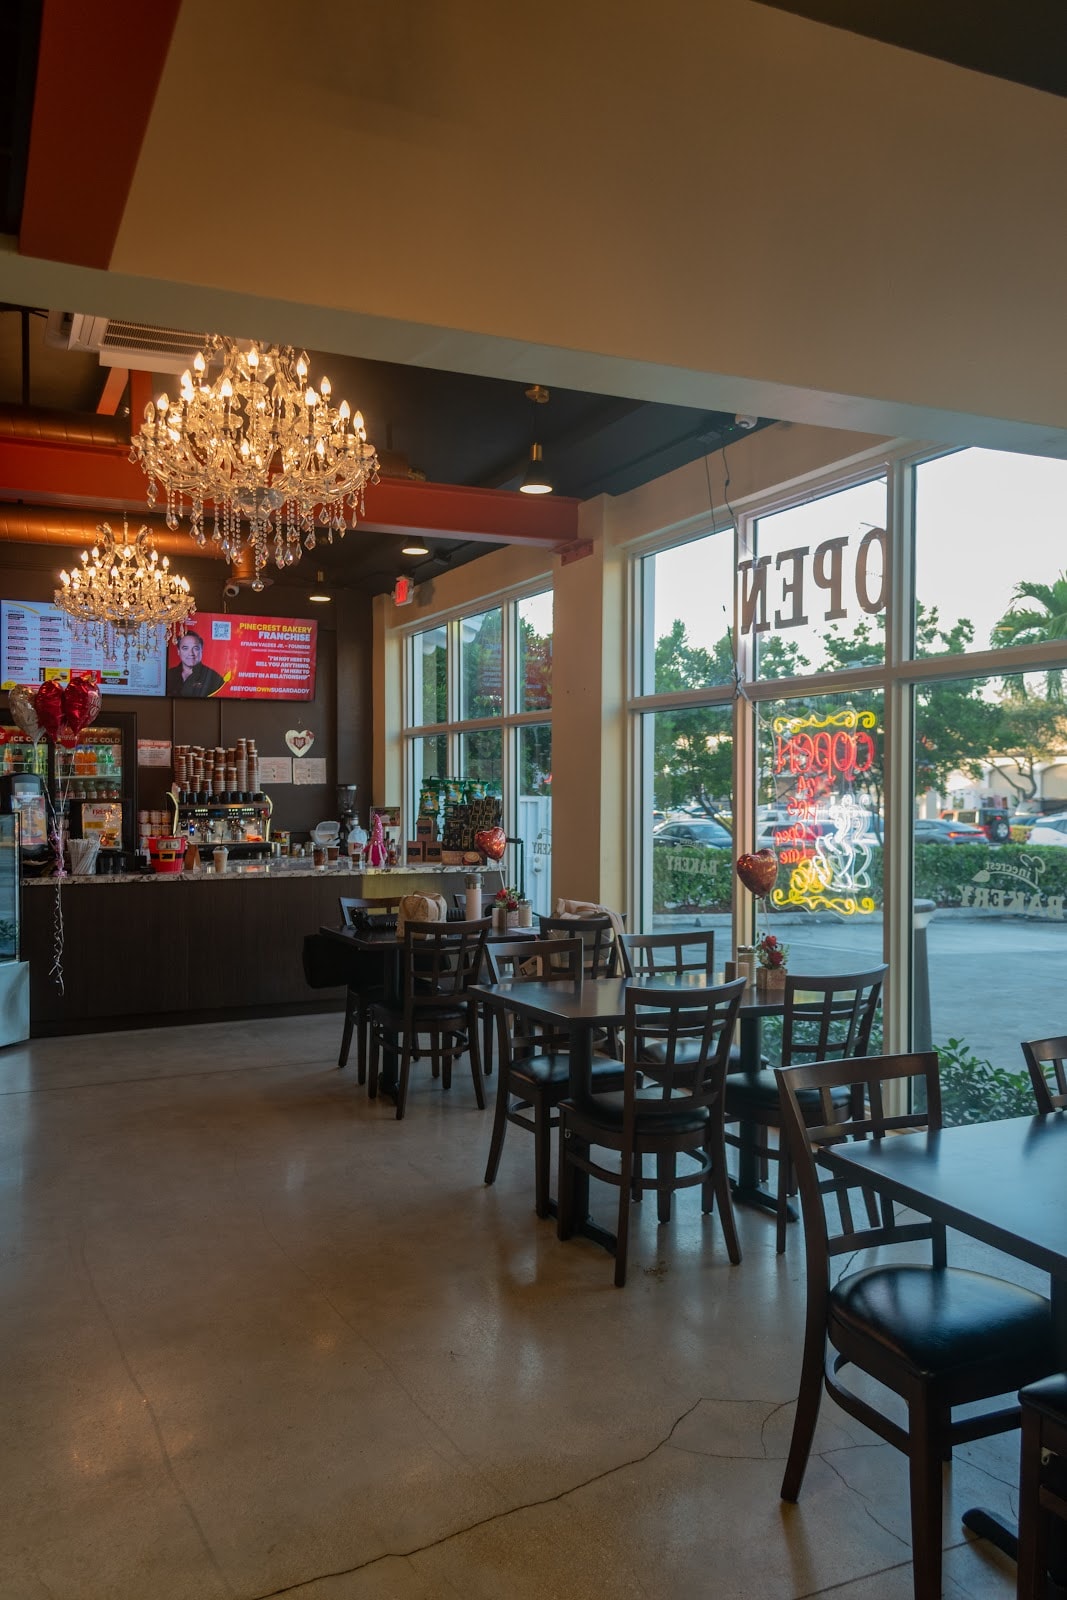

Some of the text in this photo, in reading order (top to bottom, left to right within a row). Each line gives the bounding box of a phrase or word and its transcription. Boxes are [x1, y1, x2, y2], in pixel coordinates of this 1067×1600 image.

[239, 622, 312, 633] PINECREST BAKERY
[258, 631, 311, 641] FRANCHISE
[10, 735, 24, 743] ICE
